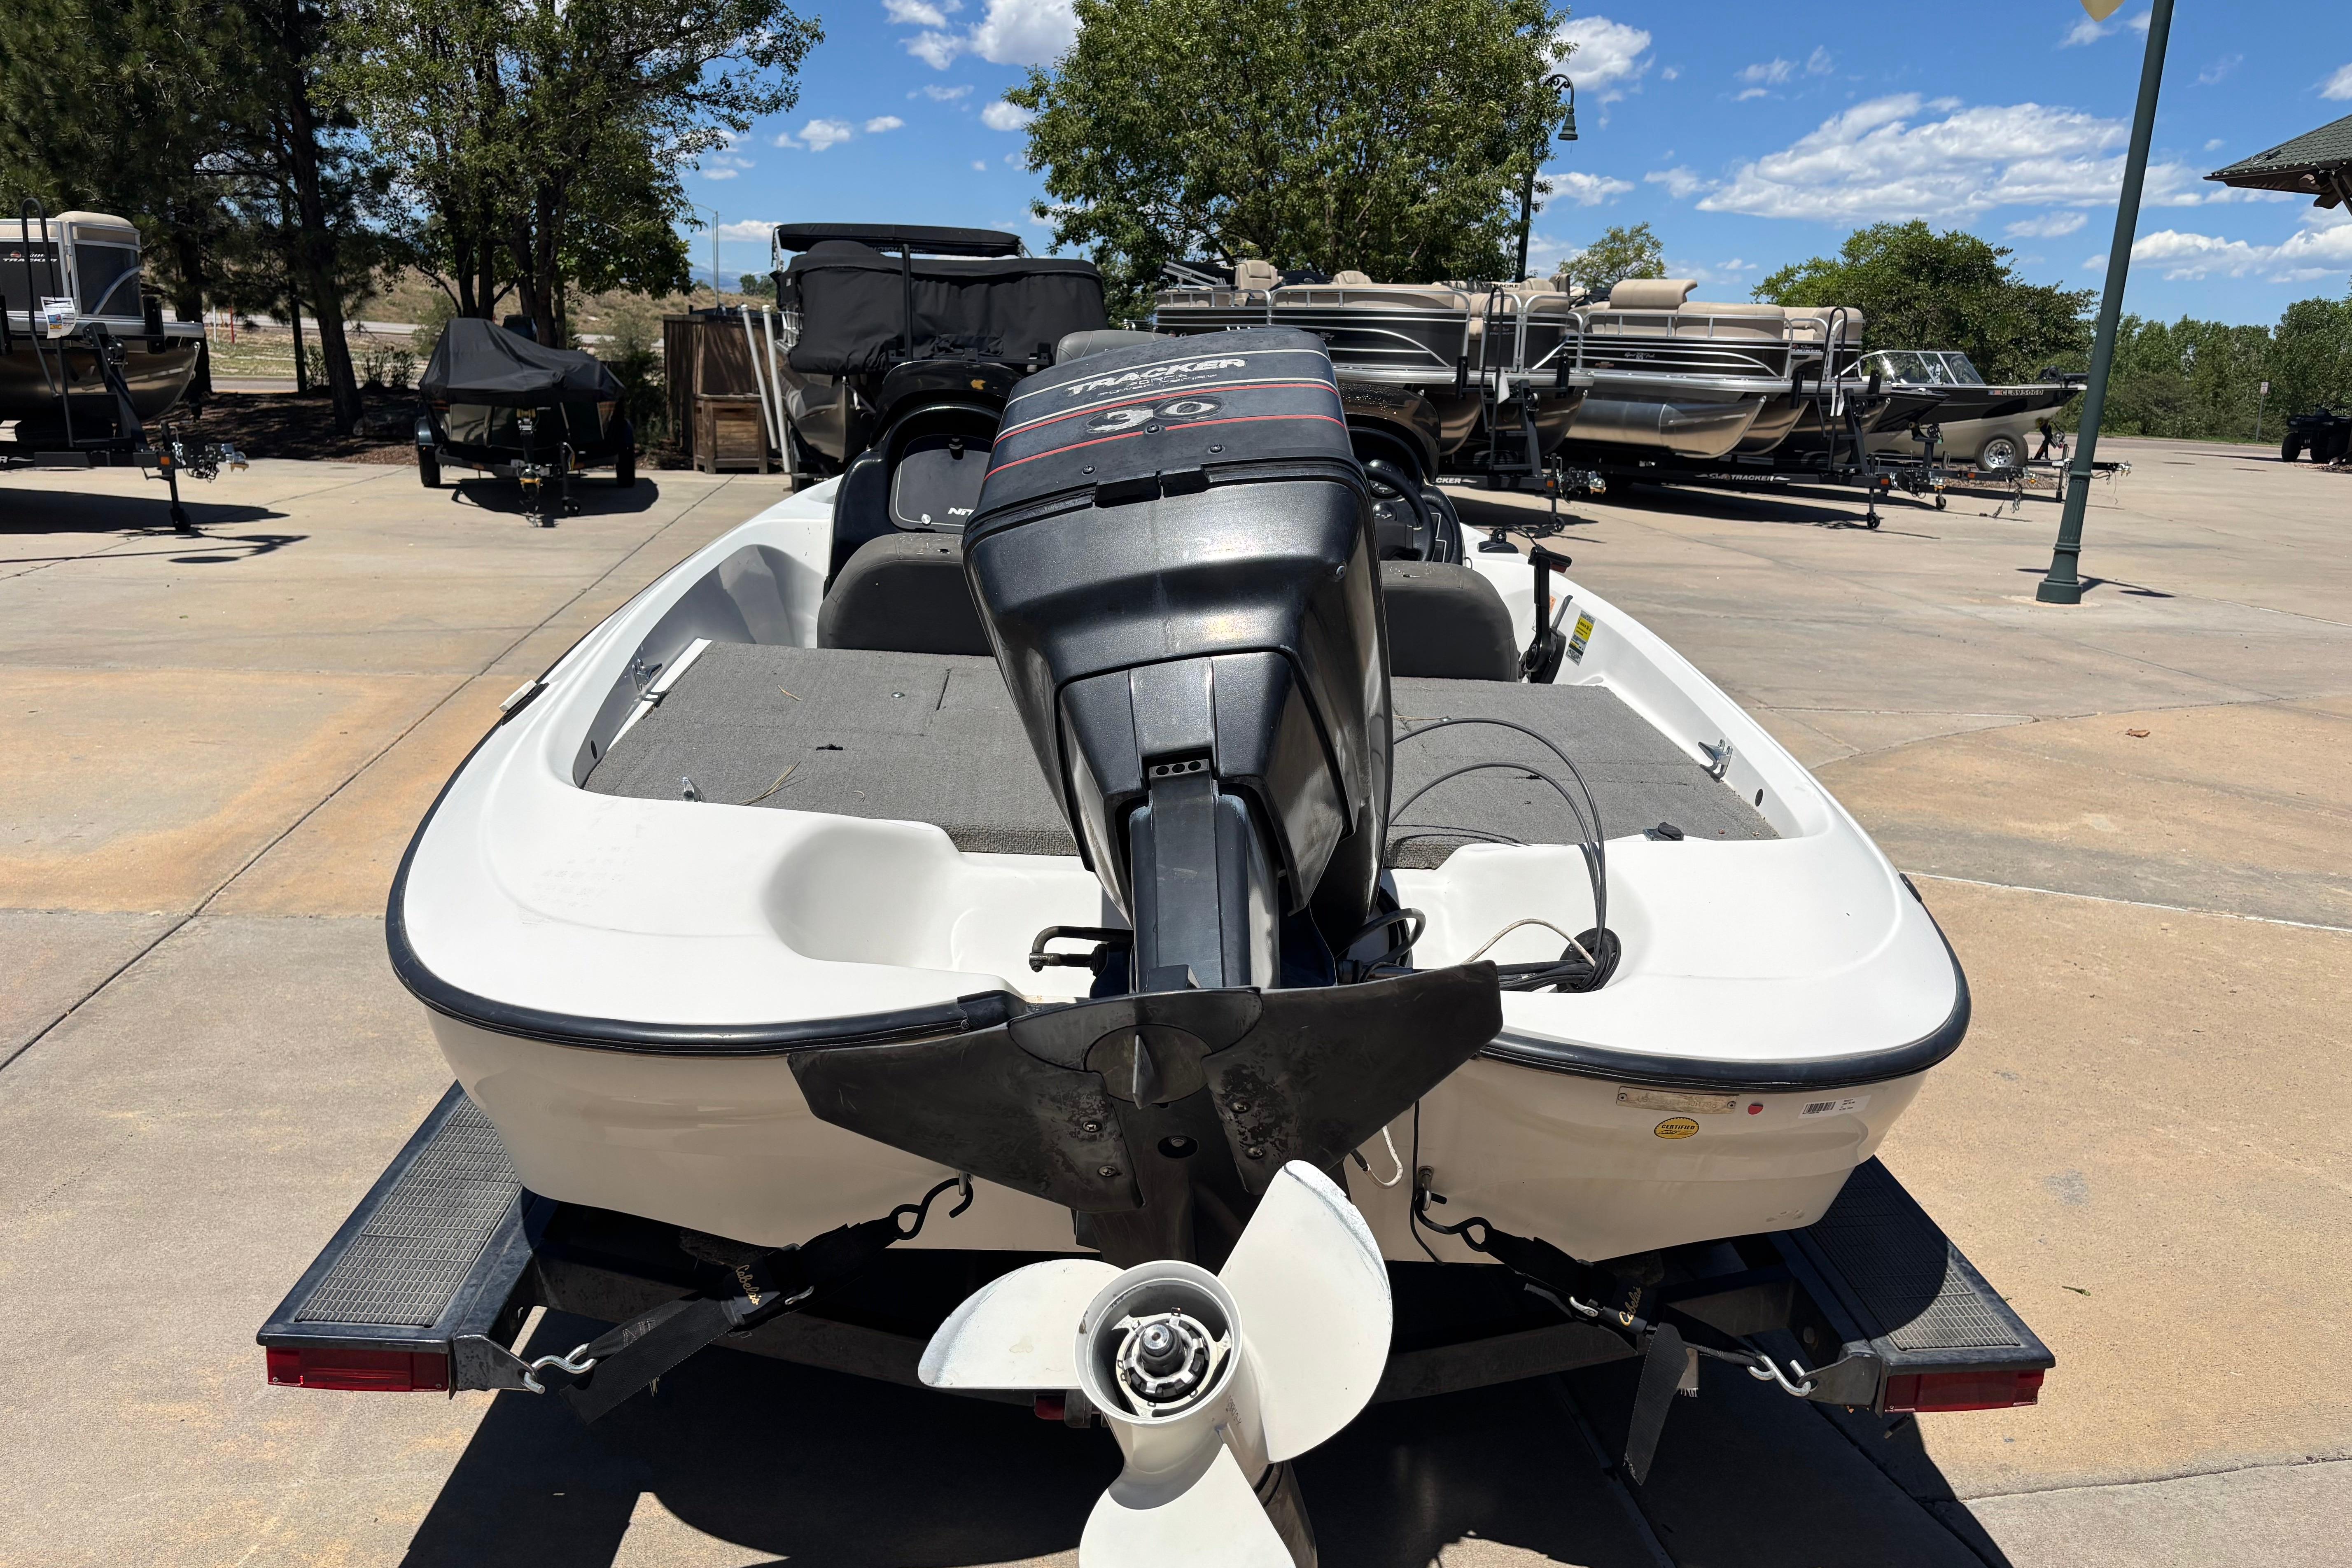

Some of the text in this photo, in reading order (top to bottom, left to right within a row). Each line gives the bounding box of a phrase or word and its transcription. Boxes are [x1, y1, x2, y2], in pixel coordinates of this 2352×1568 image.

[1066, 359, 1248, 396] TRACKER
[1087, 396, 1225, 434] 30
[948, 507, 975, 516] NIT
[735, 1265, 762, 1305] Cabela's
[1619, 1286, 1642, 1326] Cabela's
